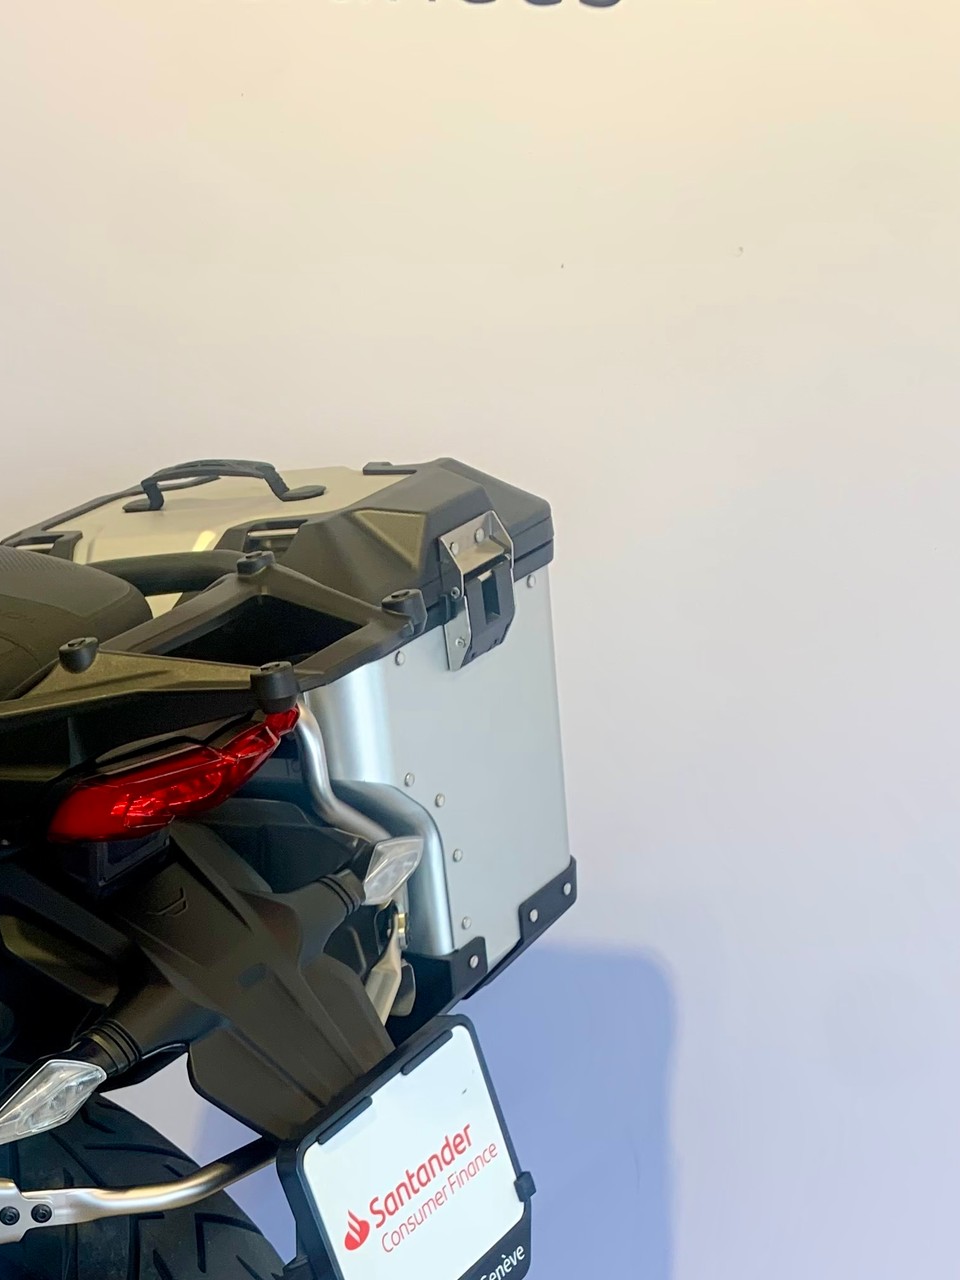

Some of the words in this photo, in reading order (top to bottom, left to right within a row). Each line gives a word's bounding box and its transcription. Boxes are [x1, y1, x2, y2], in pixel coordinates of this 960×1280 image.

[369, 1123, 472, 1229] Santander
[381, 1184, 448, 1253] Consumer
[447, 1142, 498, 1195] Finance
